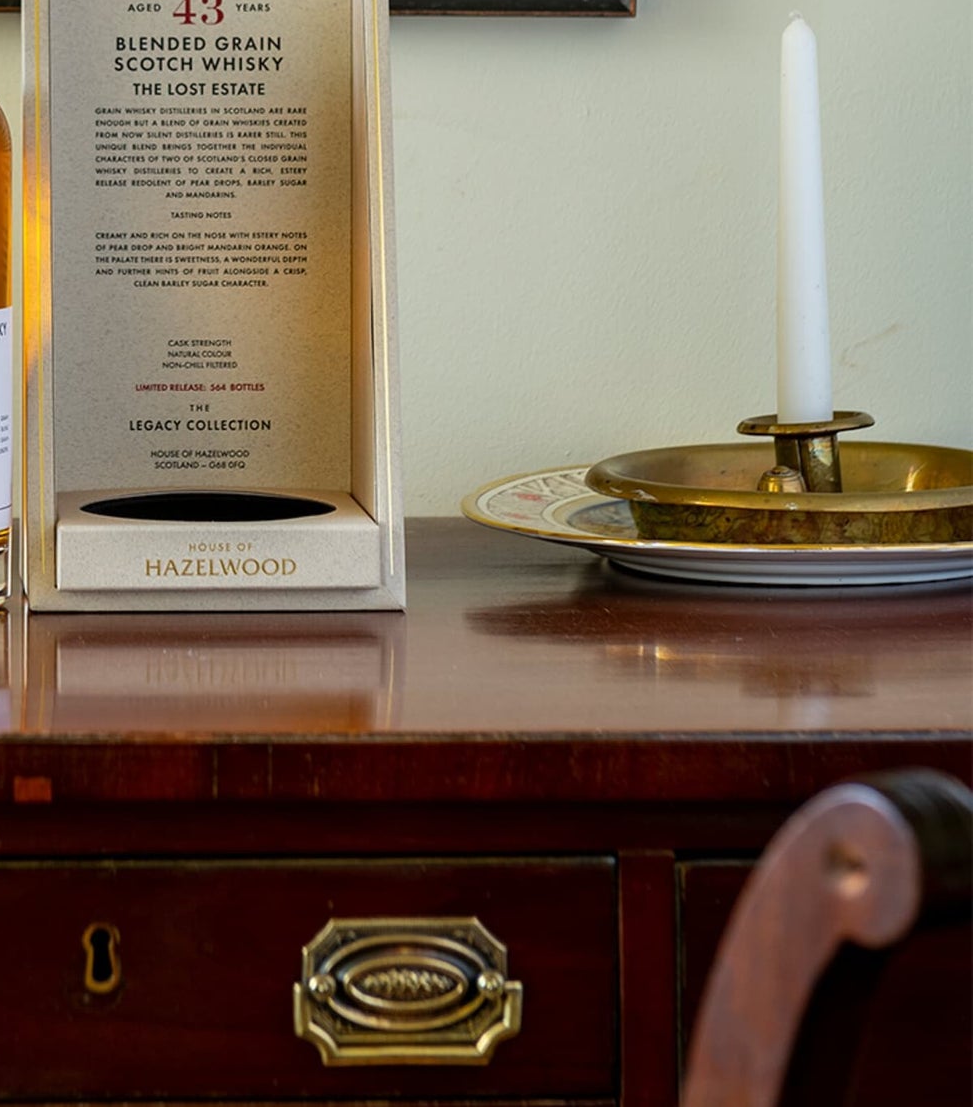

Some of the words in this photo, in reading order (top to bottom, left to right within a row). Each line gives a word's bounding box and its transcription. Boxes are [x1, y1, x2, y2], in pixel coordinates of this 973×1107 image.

[117, 38, 205, 50] BLENDED
[216, 38, 280, 50] GRAIN
[115, 58, 192, 71] SCOTCH
[202, 58, 283, 71] WHISKY
[133, 84, 161, 95] THE
[168, 84, 205, 95] LOST
[212, 84, 264, 95] ESTATE
[136, 383, 168, 391] LIMITED
[211, 383, 226, 391] 564
[230, 383, 265, 391] BOTTLES
[129, 420, 181, 430] LEGACY
[186, 420, 271, 430] COLLECTION
[150, 450, 180, 458] HOUSE
[181, 450, 193, 458] OF
[195, 450, 250, 458] HAZELWOOD
[189, 543, 230, 551] HOUSE
[236, 543, 252, 551] OF
[145, 560, 297, 575] HAZELWOOD
